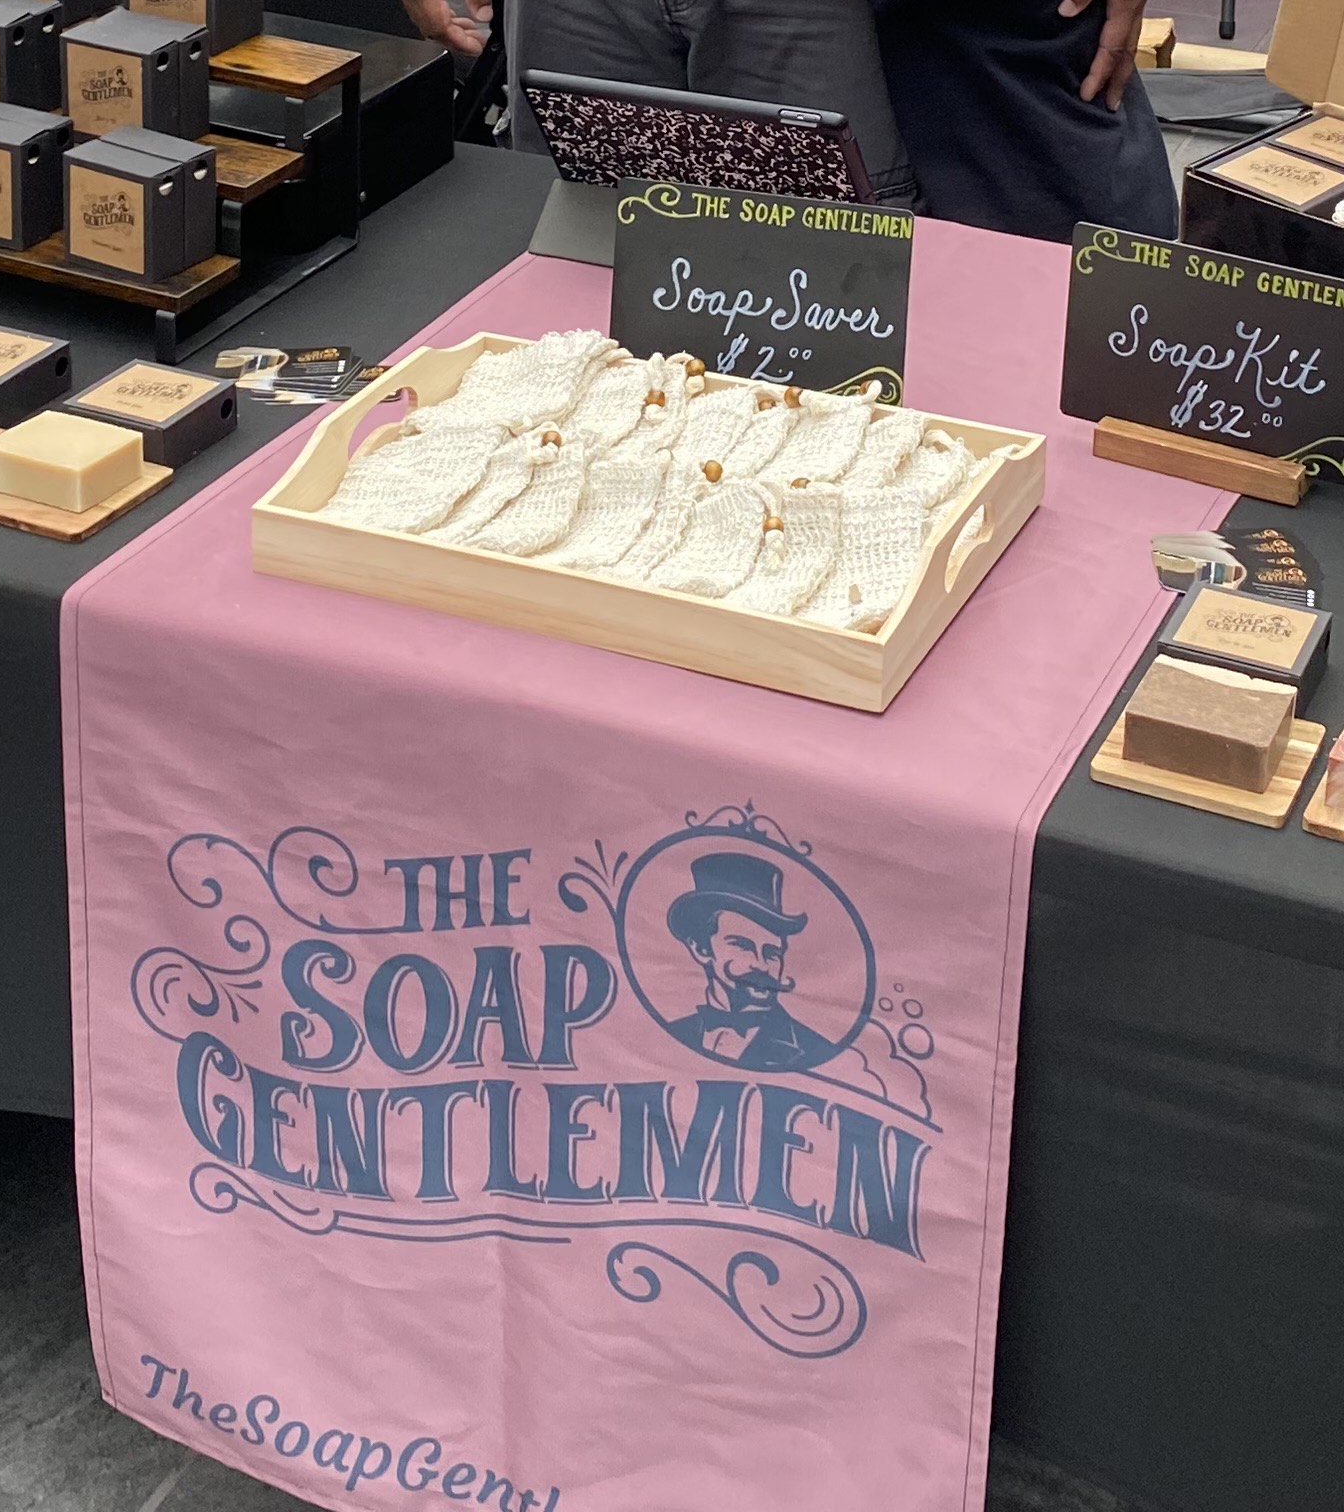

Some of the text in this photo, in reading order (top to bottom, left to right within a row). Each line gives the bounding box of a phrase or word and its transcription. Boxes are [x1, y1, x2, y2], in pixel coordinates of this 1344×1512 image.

[692, 192, 914, 239] THE SOAP GENTLEMEN
[653, 257, 894, 339] Soap Saver
[1130, 240, 1172, 269] THE
[1185, 254, 1245, 288] SOAP
[1108, 303, 1327, 408] Soap Kit
[1206, 619, 1292, 637] GENTLEMEN
[1222, 615, 1264, 625] SOAP
[383, 848, 534, 933] THE
[280, 939, 618, 1073] SOAP
[177, 1030, 934, 1264] GENTLEMEN
